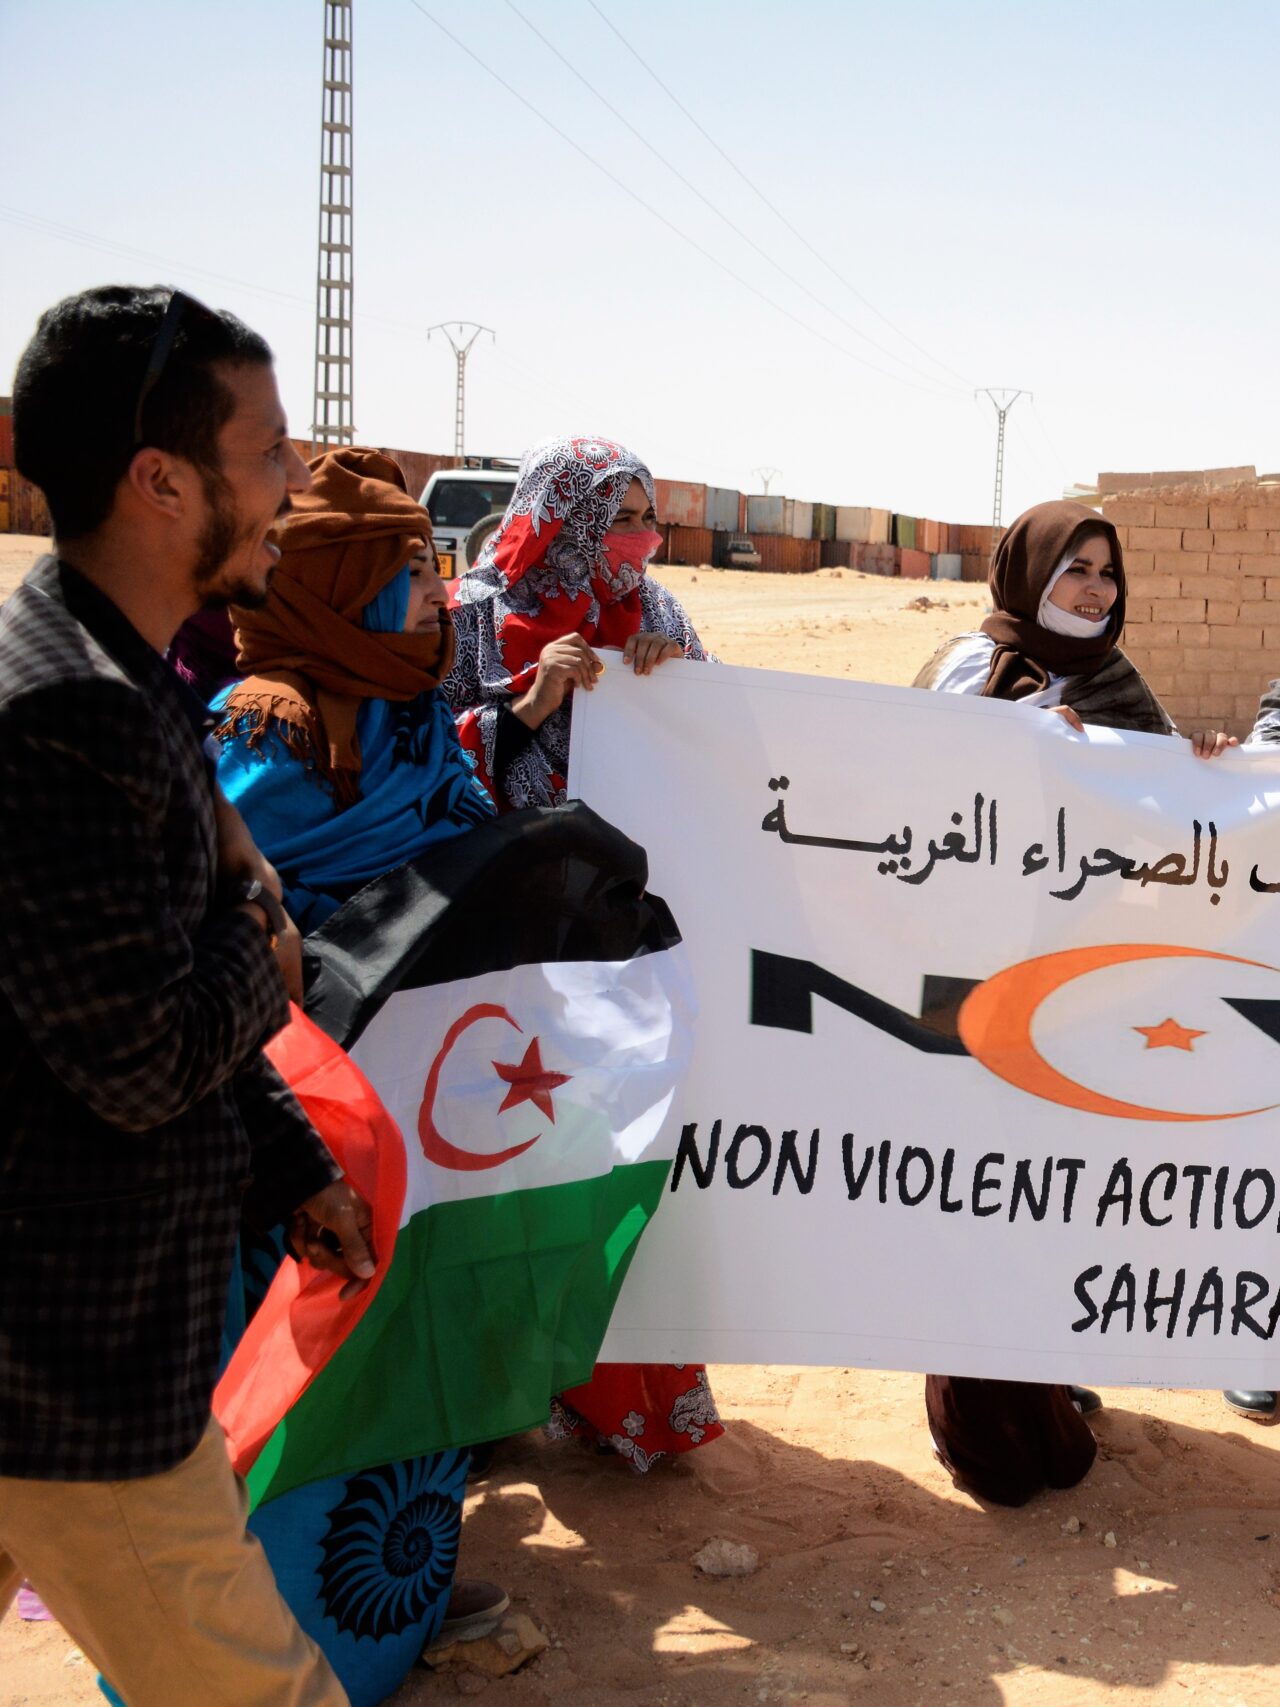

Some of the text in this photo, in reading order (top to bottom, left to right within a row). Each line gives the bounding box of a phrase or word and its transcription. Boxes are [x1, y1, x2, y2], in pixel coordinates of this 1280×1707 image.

[761, 775, 998, 886] الغربية
[1022, 807, 1229, 906] بالصحراء
[670, 1118, 820, 1196] NON
[841, 1132, 1086, 1224] VIOLENT
